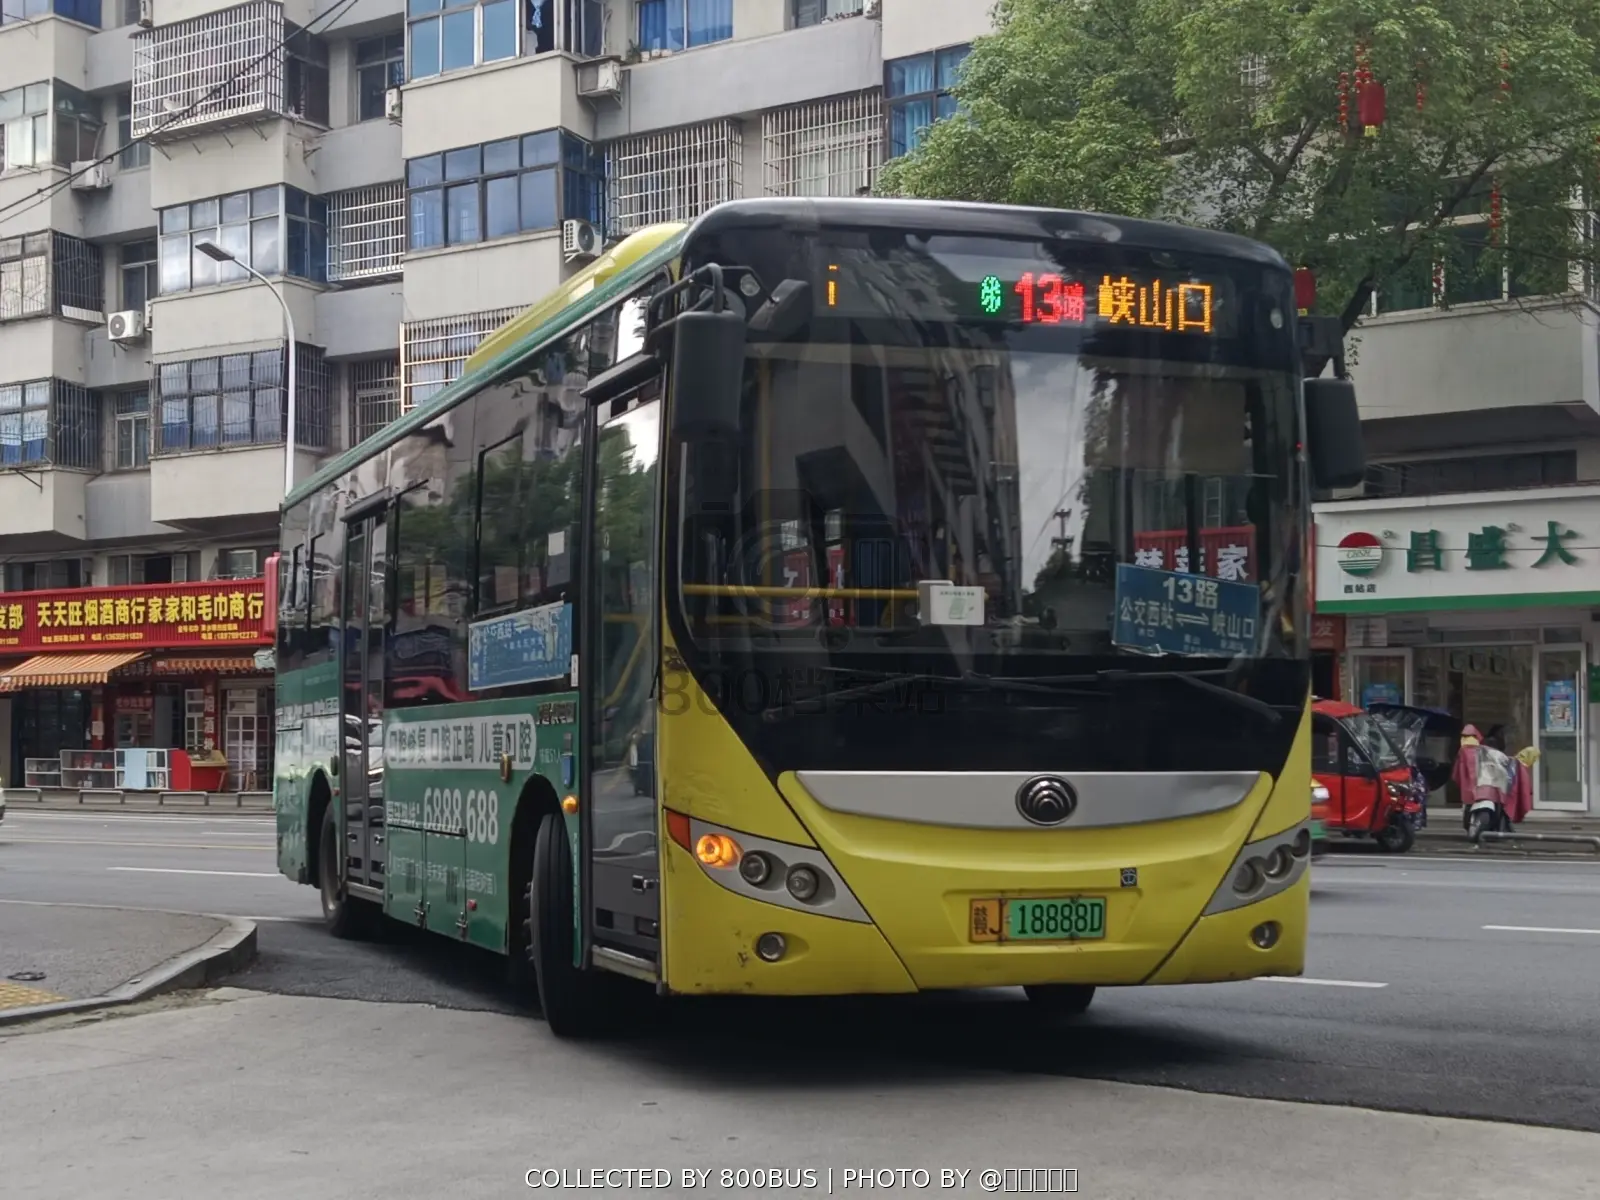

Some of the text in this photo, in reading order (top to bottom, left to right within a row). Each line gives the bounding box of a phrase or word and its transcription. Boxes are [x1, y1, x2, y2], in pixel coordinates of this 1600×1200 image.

[1099, 275, 1212, 332] 峡山口
[1407, 520, 1580, 573] 昌盛大
[148, 591, 264, 625] 家家和毛巾商行
[1162, 576, 1219, 609] 13路
[37, 596, 145, 628] 天天旺烟酒商行
[1212, 609, 1256, 639] 峡山口
[1018, 902, 1103, 935] 18888D
